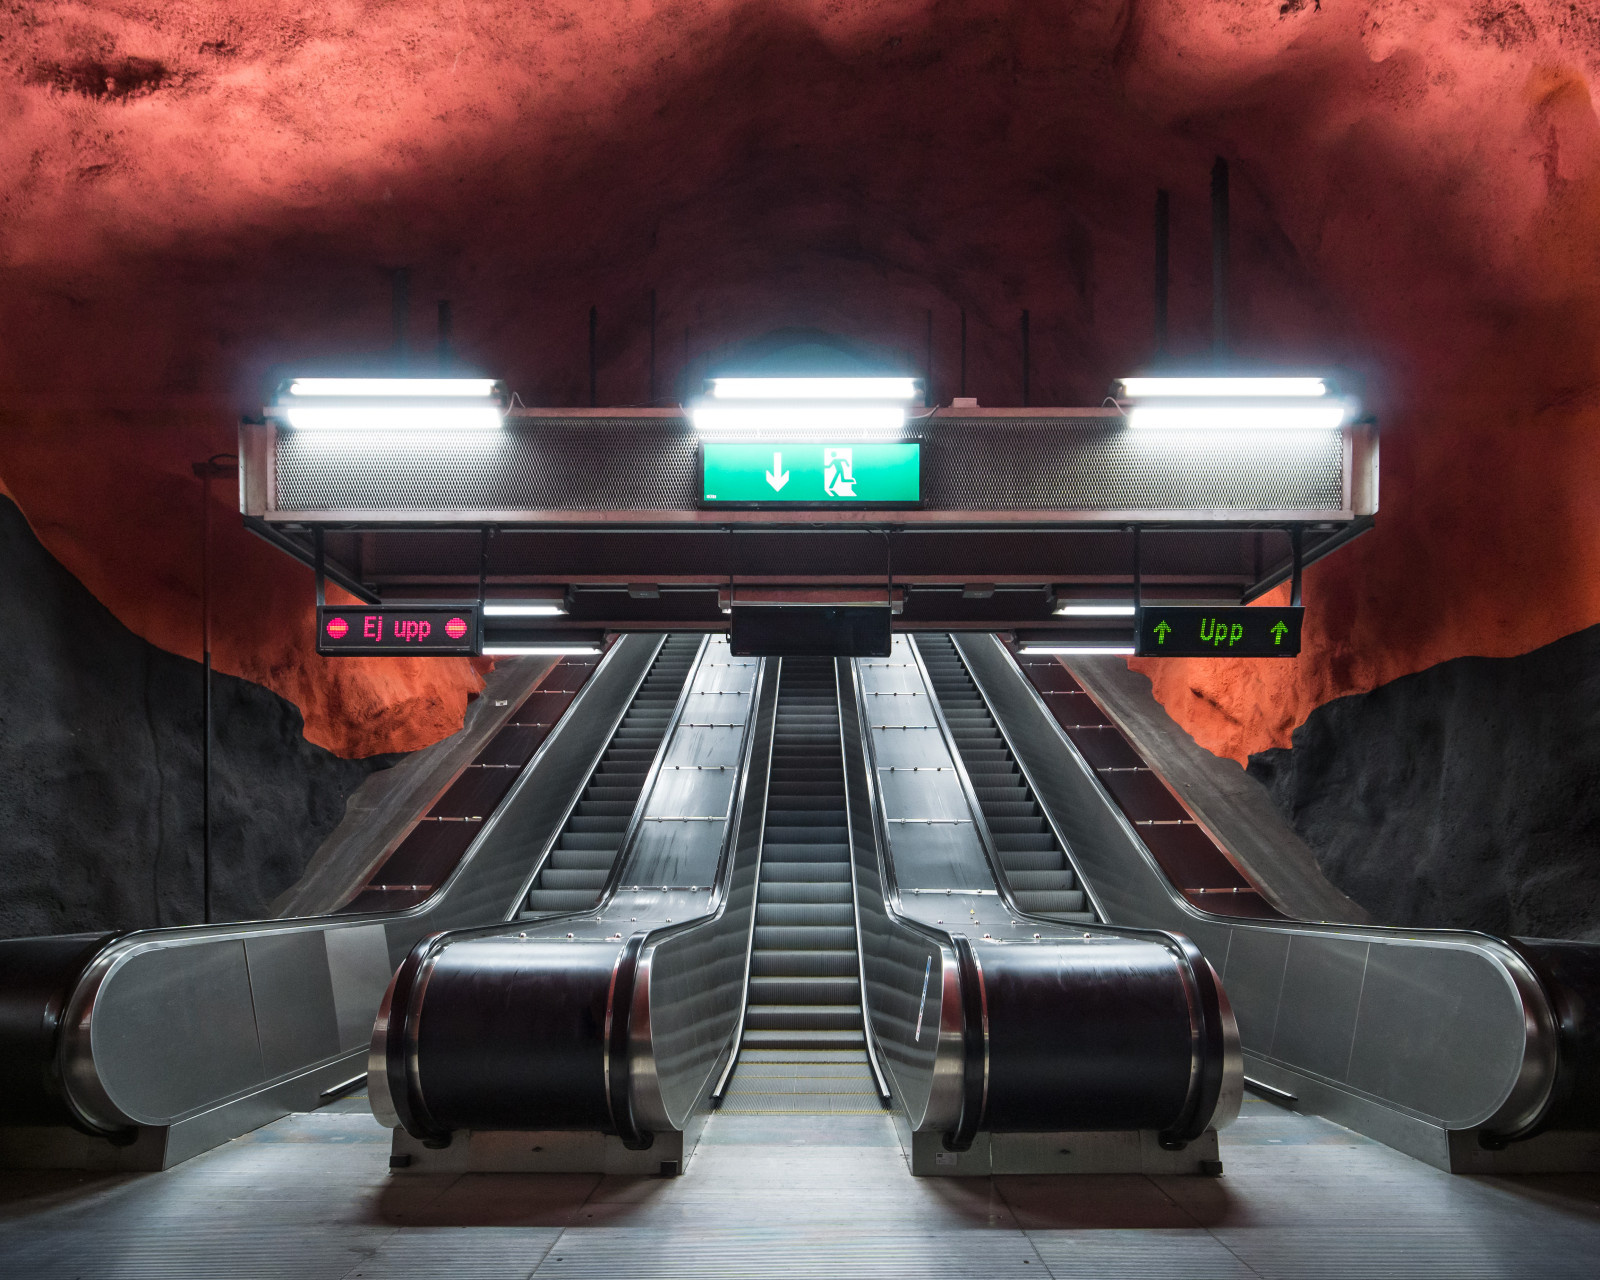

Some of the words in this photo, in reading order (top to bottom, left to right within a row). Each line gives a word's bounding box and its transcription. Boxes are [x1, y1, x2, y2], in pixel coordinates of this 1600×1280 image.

[364, 616, 383, 642] Ej
[394, 620, 431, 642] upp
[1200, 618, 1243, 646] Upp
